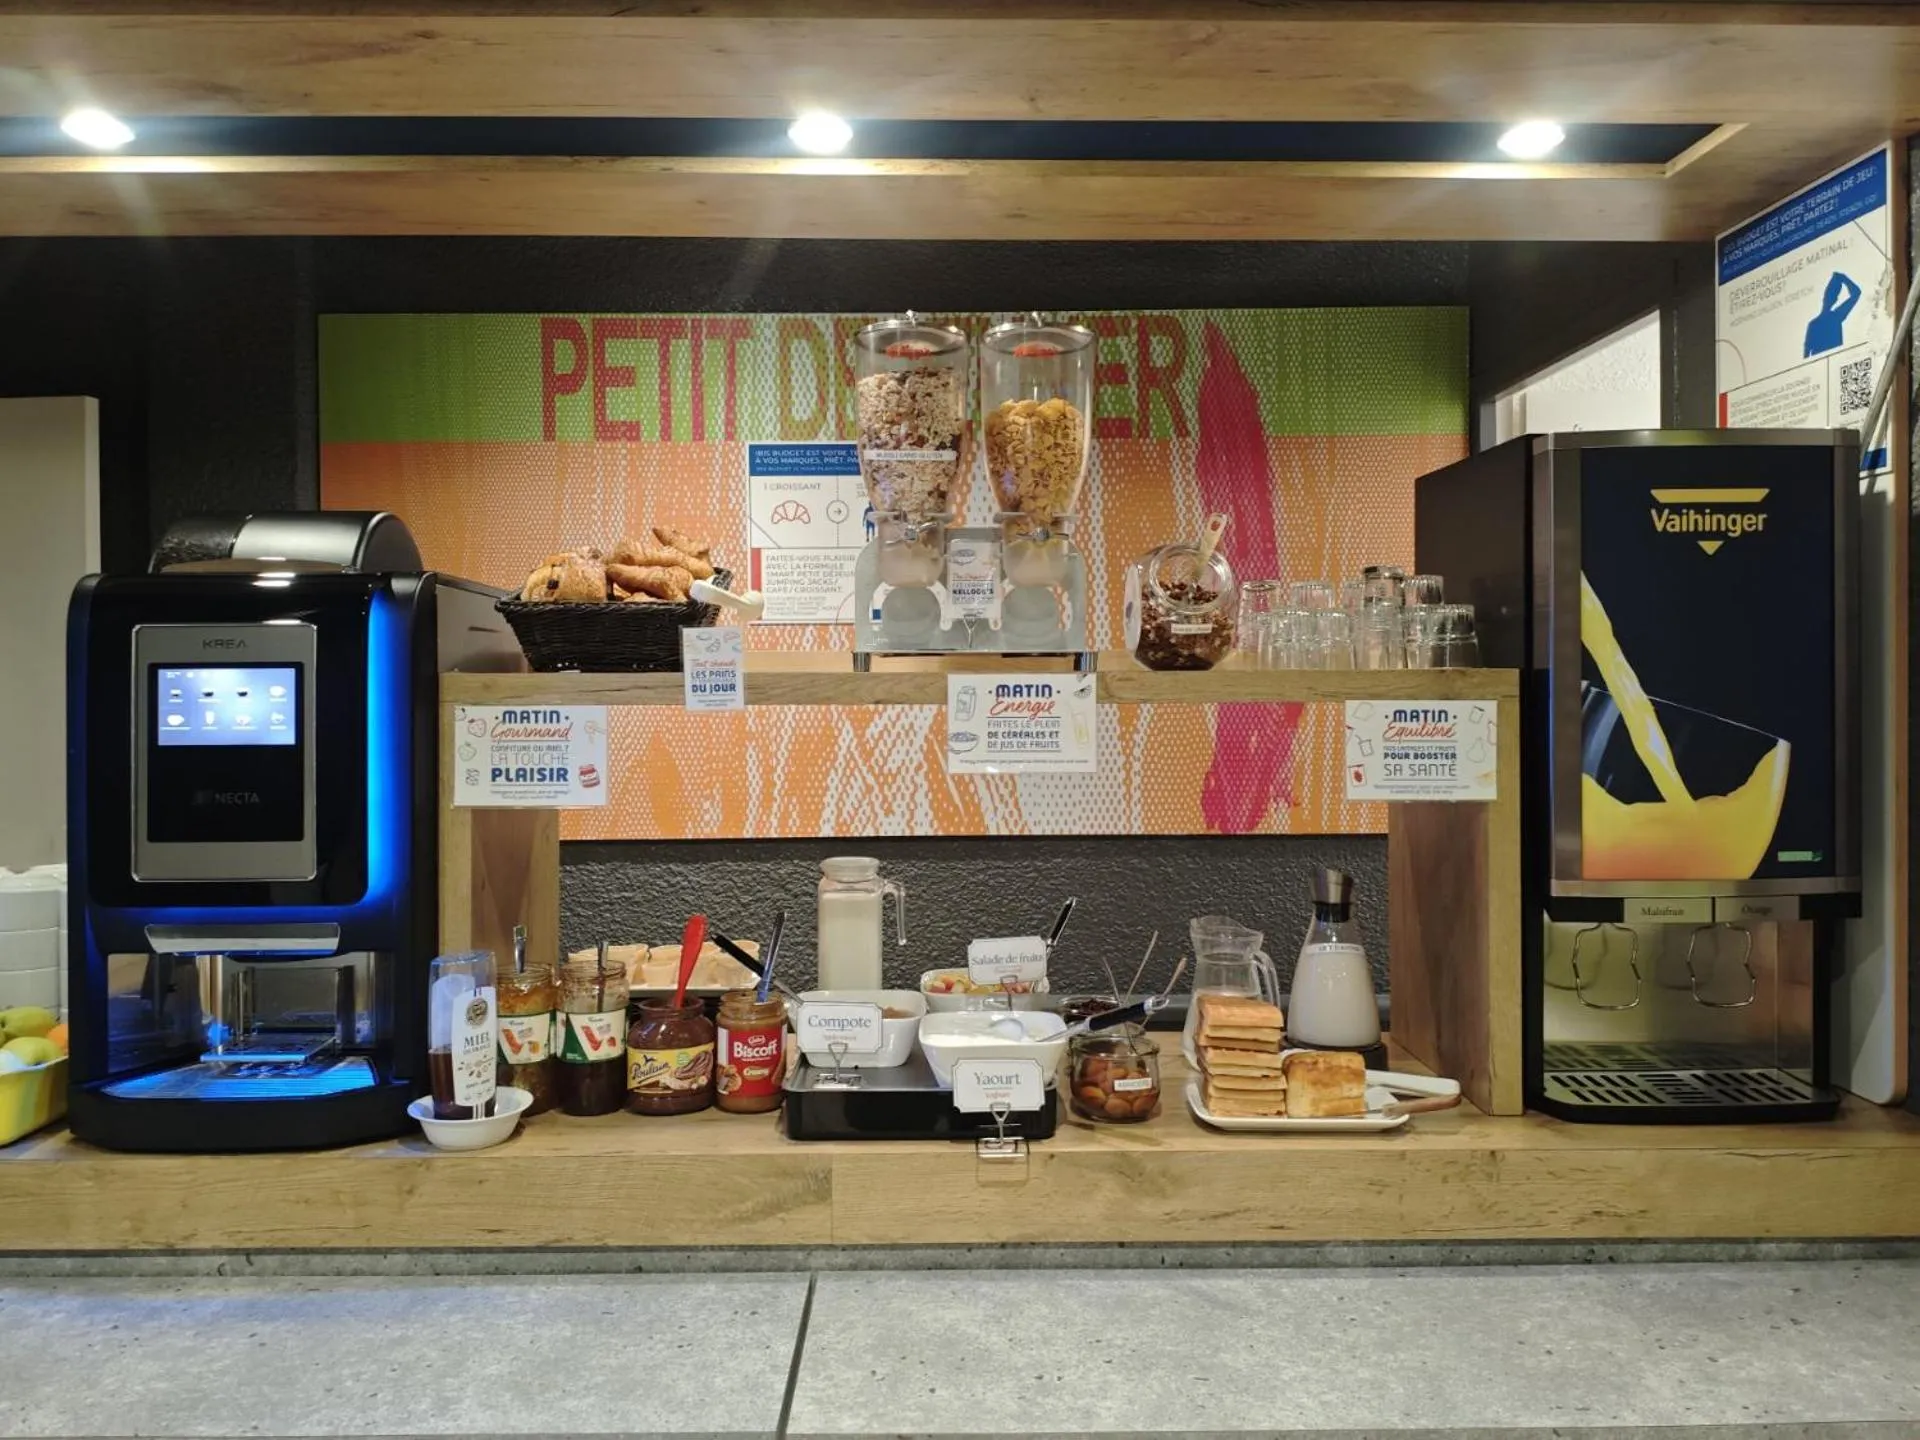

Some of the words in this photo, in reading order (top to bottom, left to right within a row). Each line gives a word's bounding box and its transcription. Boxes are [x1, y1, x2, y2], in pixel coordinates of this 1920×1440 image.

[1780, 203, 1803, 223] VOTRE
[1806, 183, 1840, 209] TERRAIN
[1843, 176, 1853, 190] DE
[540, 317, 756, 442] PETIT
[763, 456, 779, 464] VOS
[769, 482, 820, 490] CROISSANT
[1651, 508, 1768, 537] Vaihinger
[691, 670, 706, 679] LES
[692, 684, 706, 693] DU
[709, 684, 736, 694] JOUR
[996, 684, 1052, 698] MATIN
[502, 710, 560, 724] MATIN
[1393, 709, 1448, 723] MATIN
[988, 720, 1018, 728] FAITES
[1021, 720, 1032, 728] LE
[1034, 720, 1060, 728] PLEIN
[490, 722, 574, 744] Gourmand
[988, 731, 999, 739] DE
[1002, 730, 1046, 739] CÉRÉALES
[988, 740, 998, 749] DE
[1000, 740, 1014, 750] JUS
[1016, 740, 1028, 749] DE
[1030, 740, 1060, 748] FRUITS
[491, 752, 508, 766] LA
[512, 752, 569, 766] TOUCHE
[1384, 752, 1410, 760] POUR
[1413, 752, 1457, 760] BOOSTER
[491, 767, 569, 782] PLAISIR
[1384, 764, 1402, 776] SA
[1408, 760, 1456, 776] SANTÉ
[971, 954, 1004, 966] Salade
[1005, 952, 1017, 964] de
[1018, 952, 1044, 963] fruits
[808, 1014, 872, 1032] Compote
[734, 1039, 778, 1058] Biscoff
[631, 1062, 670, 1080] Poulain
[974, 1072, 1022, 1086] Yaourt
